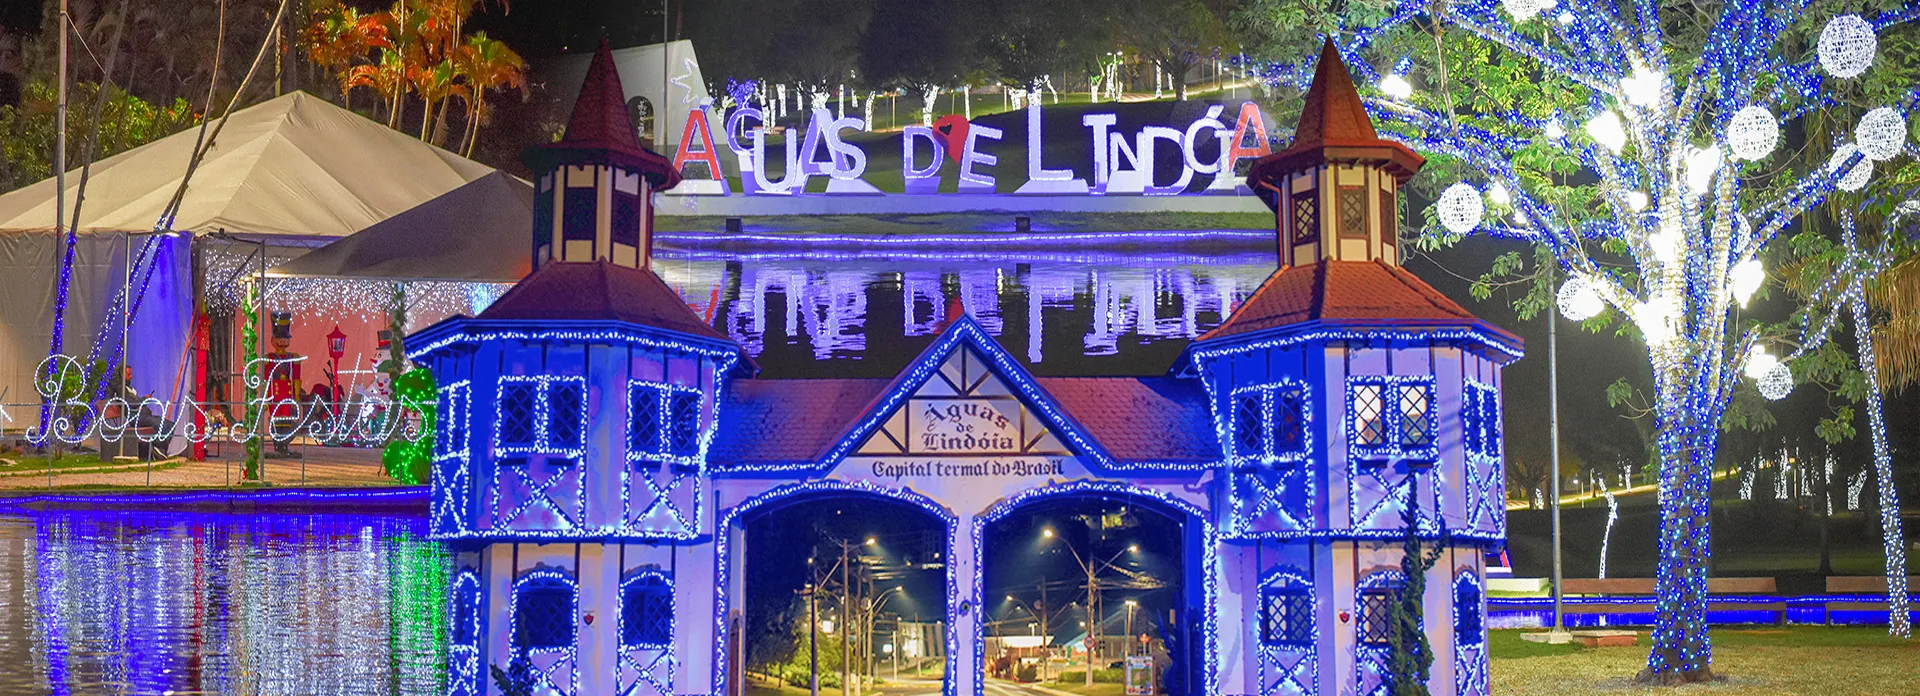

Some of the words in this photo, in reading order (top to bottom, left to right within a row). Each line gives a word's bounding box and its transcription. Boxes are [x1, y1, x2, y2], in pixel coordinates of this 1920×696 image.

[672, 96, 867, 195] ÁGUAS
[903, 124, 1003, 187] DE
[25, 353, 212, 444] Boas
[230, 352, 429, 444] Festas
[923, 402, 1010, 432] Águas
[955, 422, 974, 433] de
[921, 431, 1014, 452] Lindóia
[872, 460, 932, 482] Capital
[936, 460, 989, 477] termal
[991, 460, 1010, 476] do
[1013, 459, 1065, 477] Brasil
